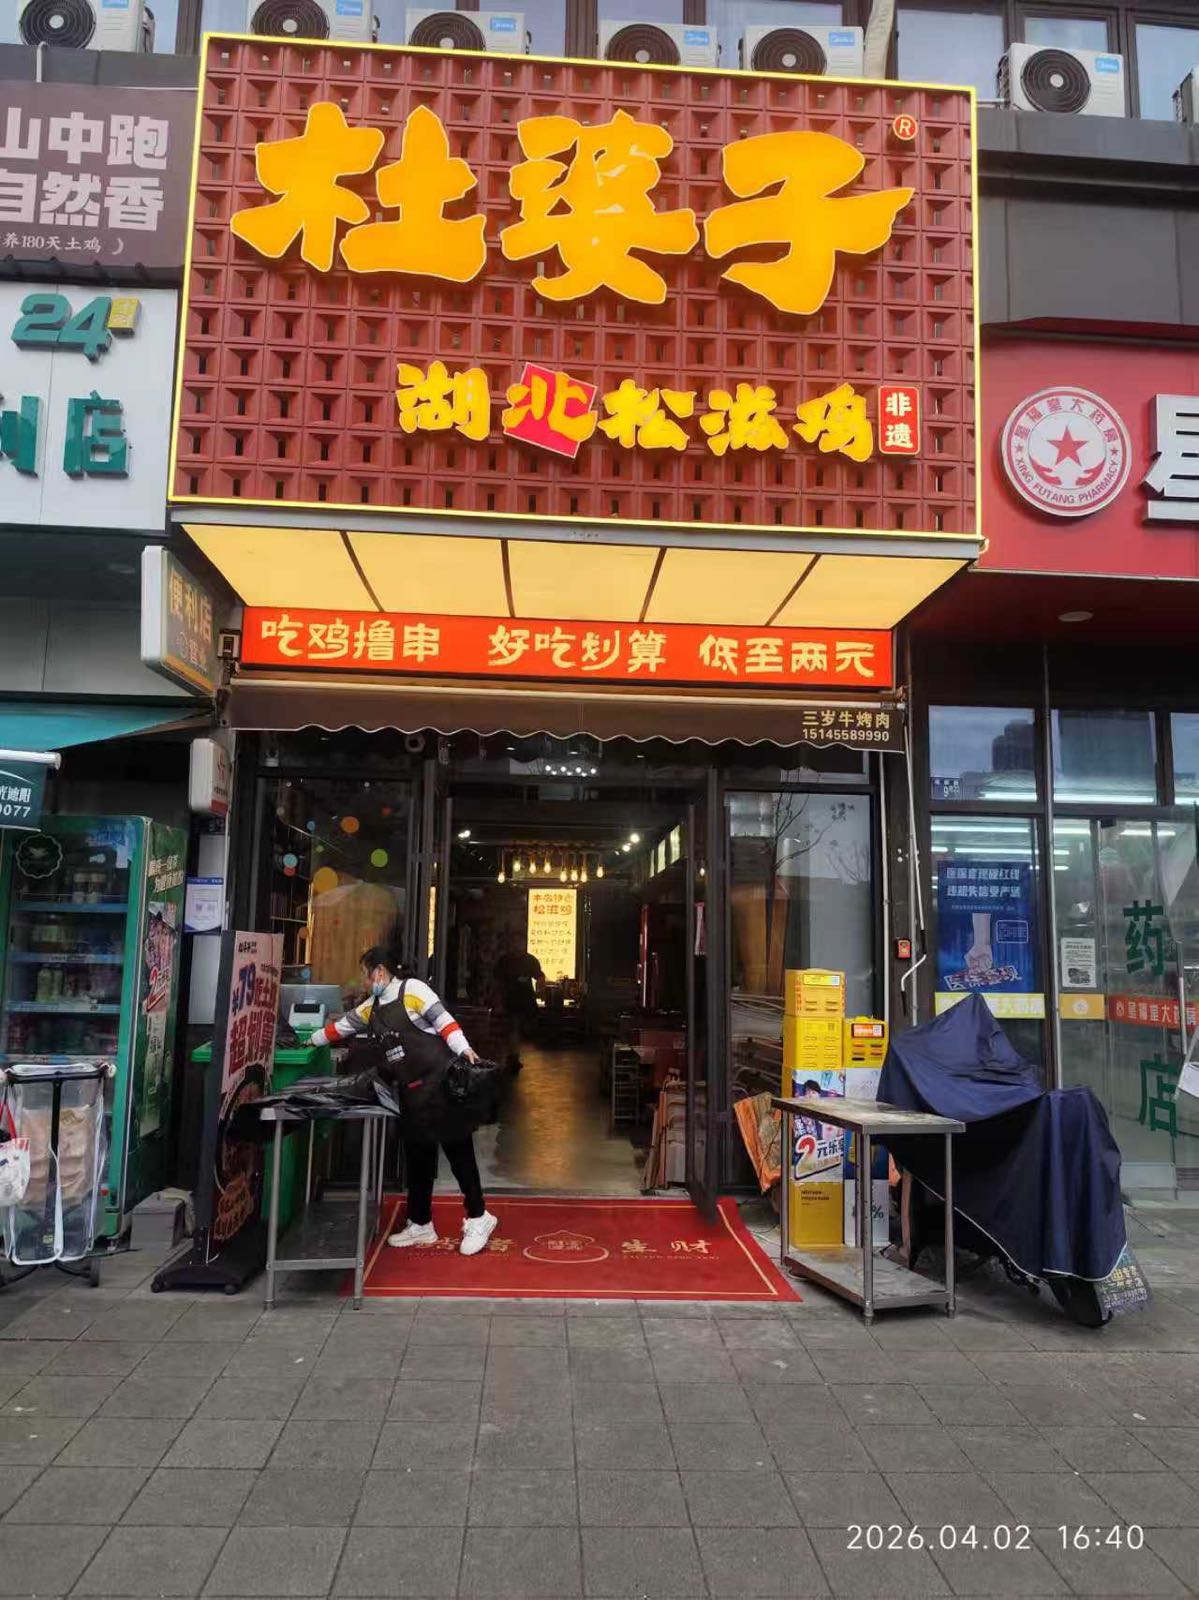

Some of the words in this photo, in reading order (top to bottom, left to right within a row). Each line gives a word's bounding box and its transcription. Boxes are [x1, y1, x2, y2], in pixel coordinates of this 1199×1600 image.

[229, 101, 915, 316] 杜婆子
[396, 360, 874, 462] 湖北松滋鸡
[1015, 456, 1034, 483] XING
[1033, 482, 1075, 505] FUTANG
[1078, 459, 1120, 502] PHARMACY
[260, 613, 441, 664] 吃鸡撸串
[487, 624, 668, 673] 好吃划算
[698, 634, 875, 679] 低至两元
[802, 709, 890, 729] 三岁牛烤肉
[802, 728, 890, 742] 15145589990
